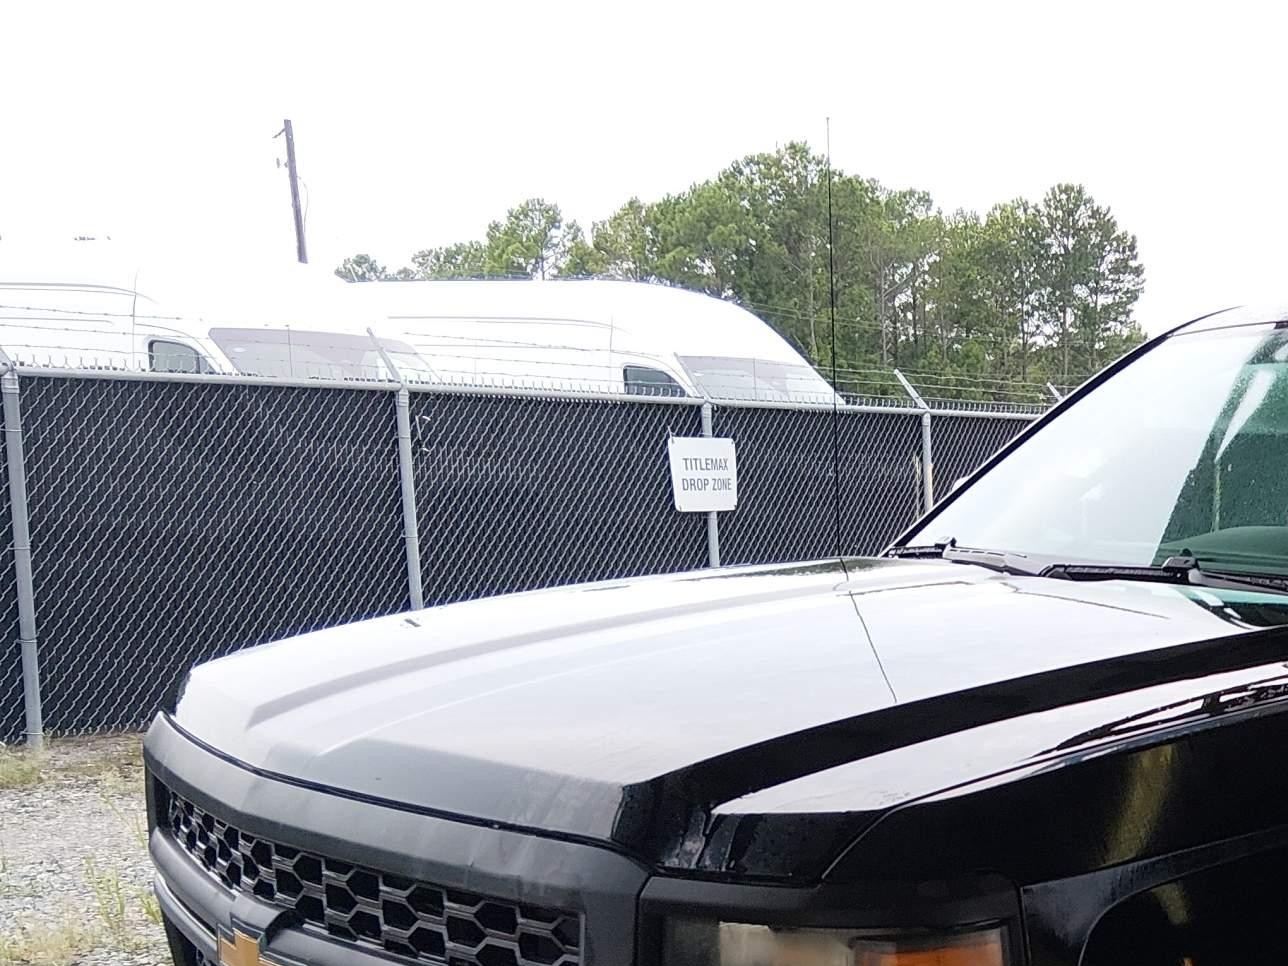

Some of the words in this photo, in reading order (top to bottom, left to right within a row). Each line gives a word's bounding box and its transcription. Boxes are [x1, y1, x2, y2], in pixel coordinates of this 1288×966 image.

[682, 457, 729, 471] TITLEMAX
[682, 478, 710, 491] DROP
[711, 478, 732, 491] ZONE
